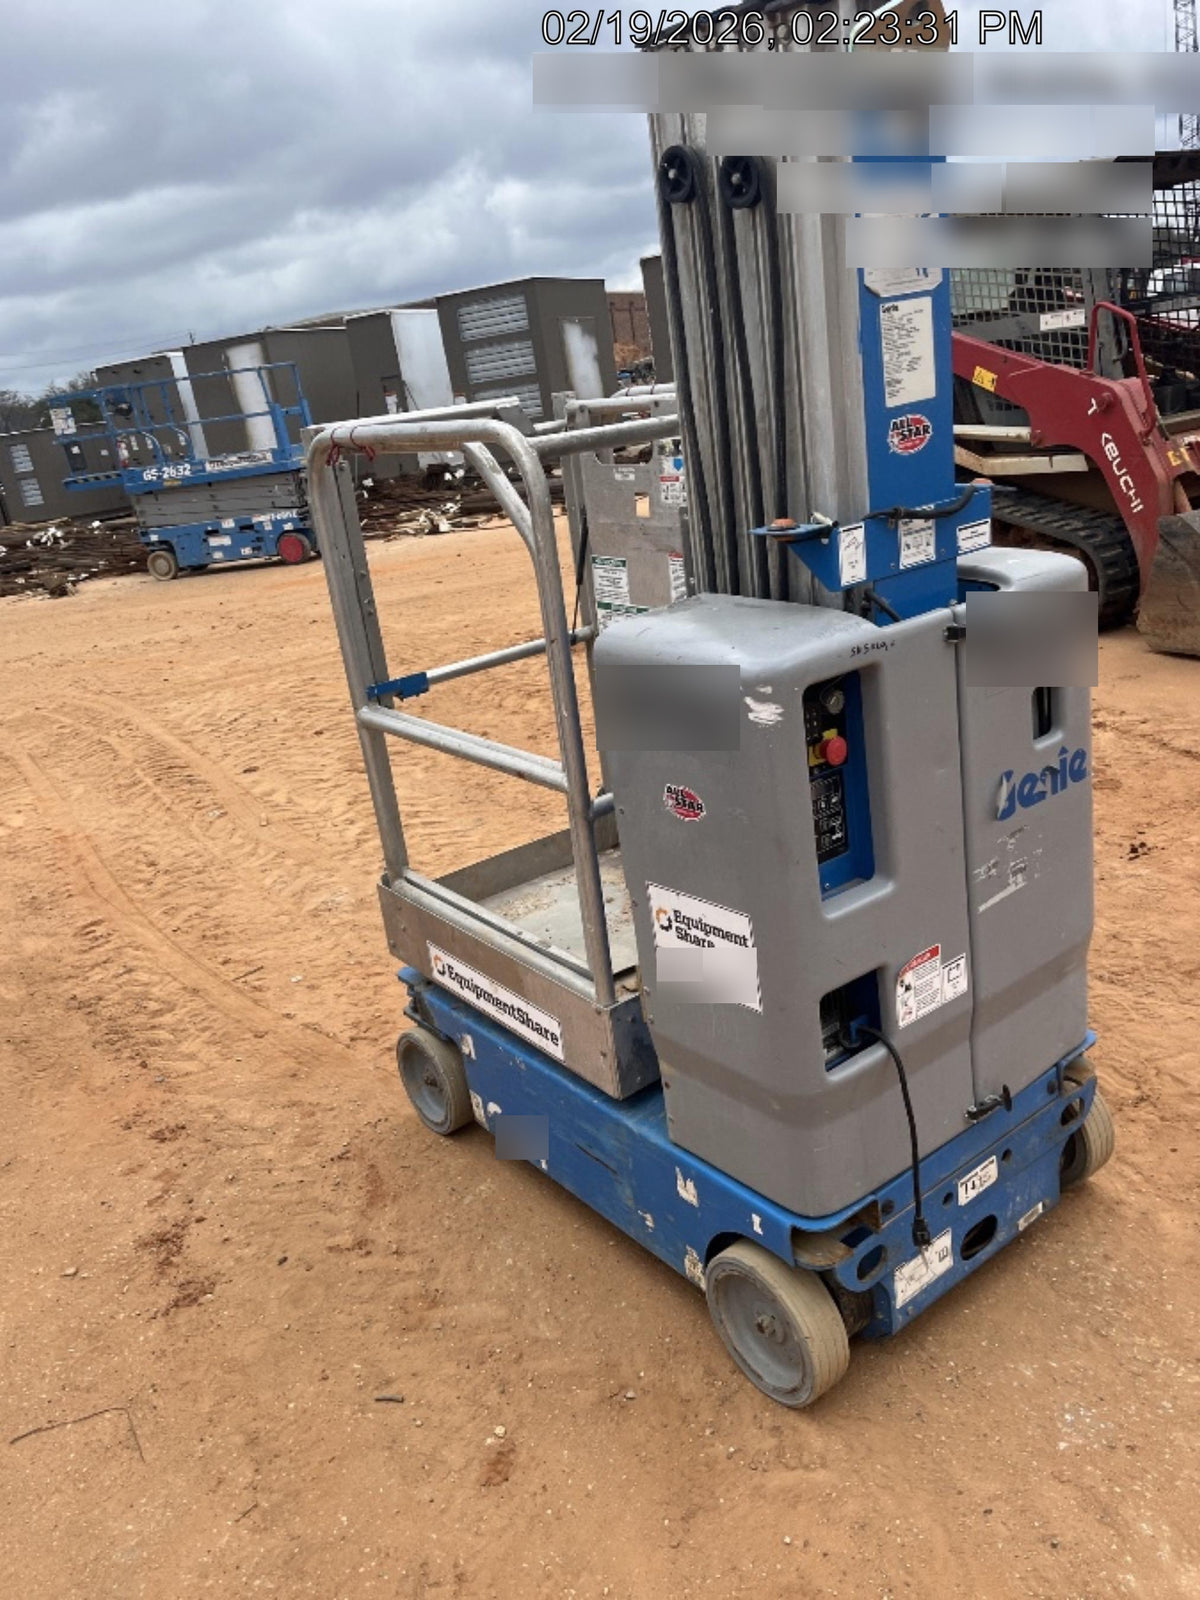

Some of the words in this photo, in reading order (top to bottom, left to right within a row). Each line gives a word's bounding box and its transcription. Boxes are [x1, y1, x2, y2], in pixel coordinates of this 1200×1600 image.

[900, 424, 931, 442] STAR
[673, 909, 750, 949] Equipment
[675, 925, 716, 949] Share
[445, 962, 560, 1047] EquipmentShare
